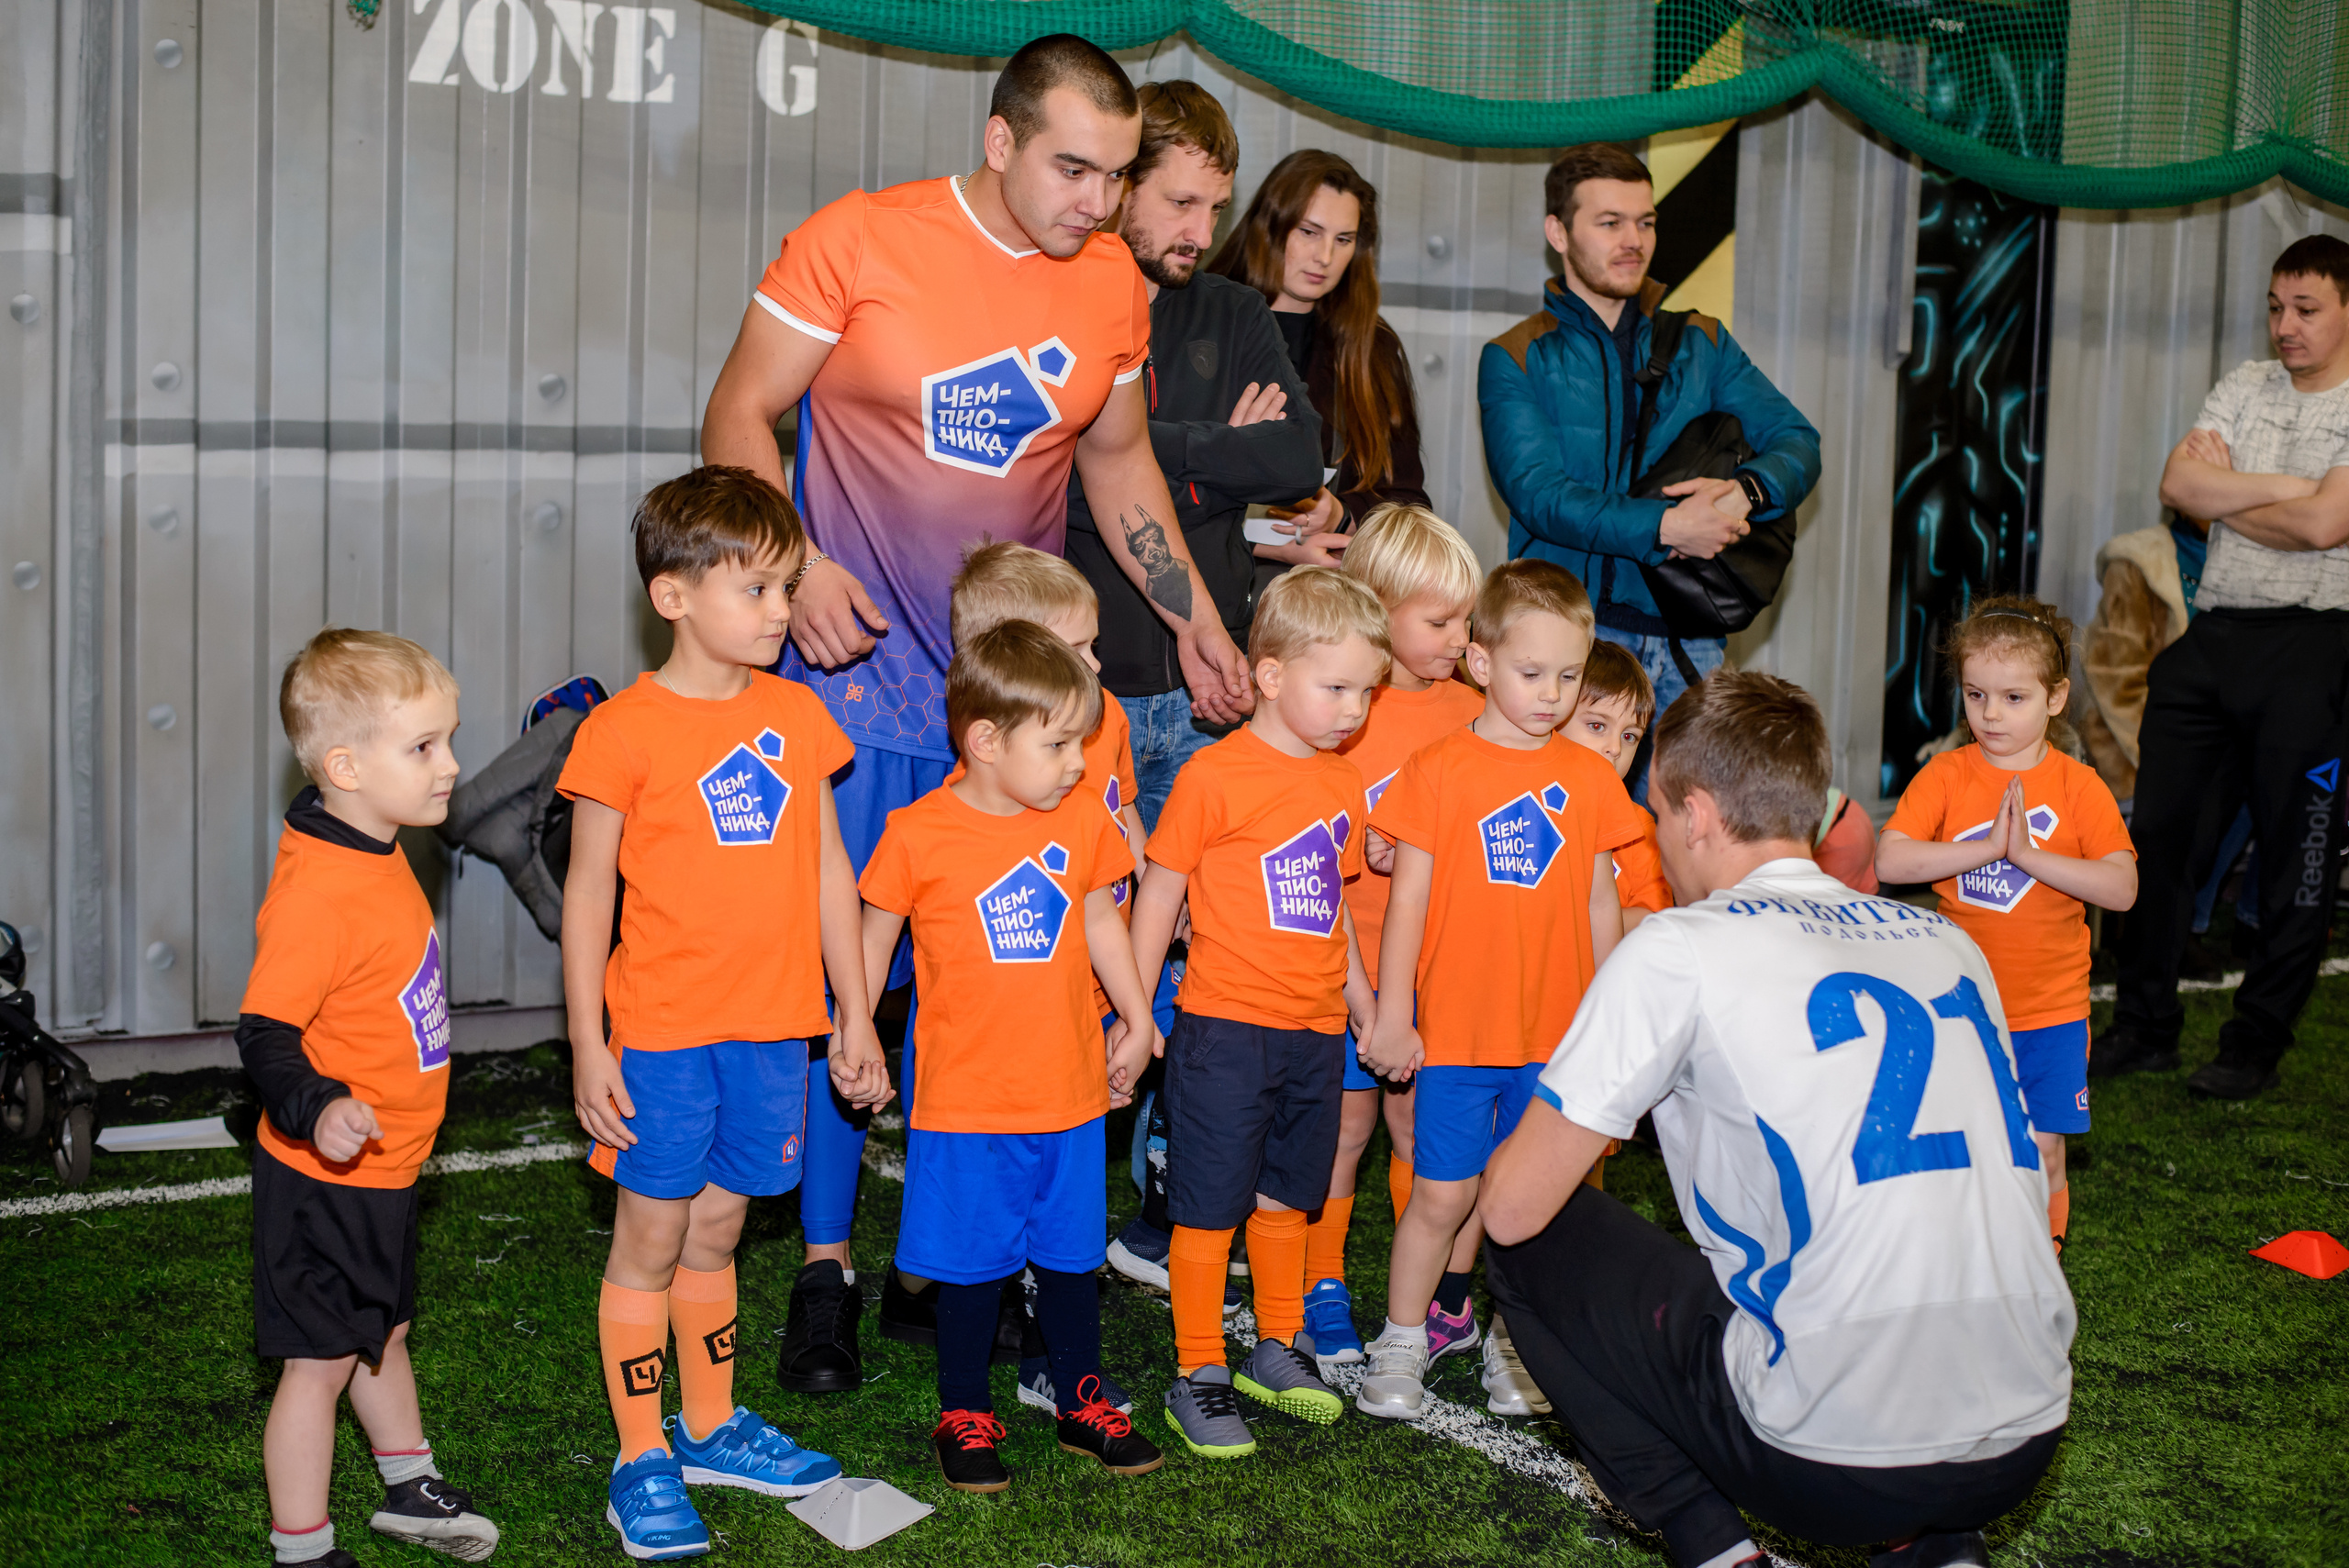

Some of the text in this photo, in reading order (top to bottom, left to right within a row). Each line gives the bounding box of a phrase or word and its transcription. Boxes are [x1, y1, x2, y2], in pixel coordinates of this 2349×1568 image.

[408, 0, 819, 117] ZONE G
[940, 382, 1011, 407] ЧЕМ-
[937, 408, 1010, 429] ПИО-
[938, 426, 1008, 458] НИКА
[707, 771, 752, 798] ЧЕМ-
[715, 793, 763, 815] ПИО-
[720, 811, 771, 832] НИКА
[1488, 817, 1531, 840] ЧЕМ-
[1490, 837, 1534, 855] ПИО-
[2295, 793, 2333, 906] Reebok
[1275, 851, 1326, 878] ЧЕМ-
[1493, 856, 1538, 876] НИКА
[1276, 875, 1328, 896] ПИО-
[1965, 873, 2014, 898] НИКА
[986, 885, 1036, 916] ЧЕМ-
[1280, 897, 1332, 921] НИКА
[1727, 897, 1804, 917] ФК
[991, 908, 1043, 932] ПИО-
[1798, 921, 1940, 941] ПОДОЛЬСК
[996, 929, 1051, 951] НИКА
[426, 1017, 451, 1052] НИК
[1806, 972, 2040, 1186] 21
[1382, 1340, 1414, 1350] Sport
[647, 1534, 672, 1542] VIKING
